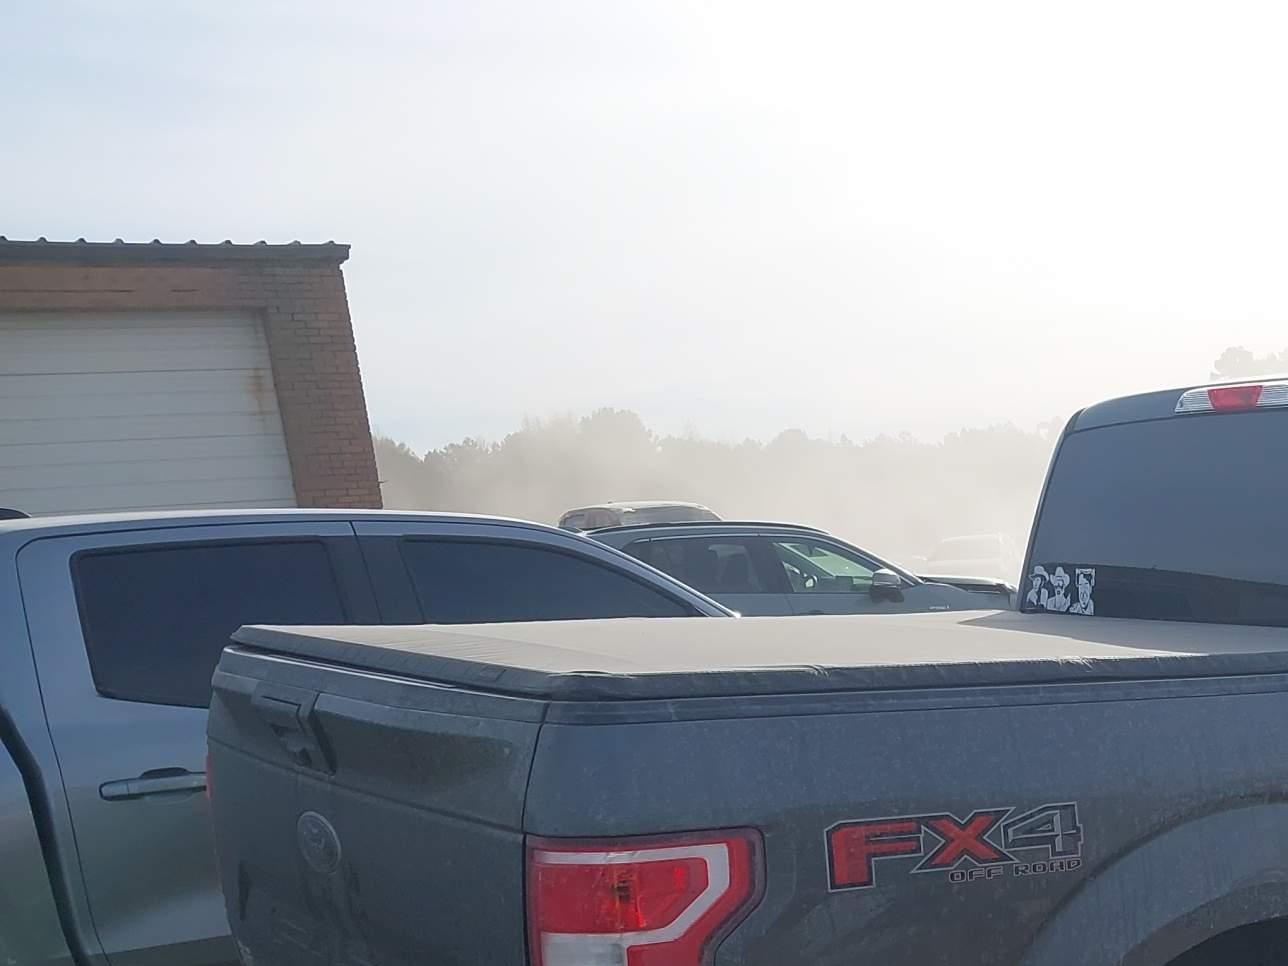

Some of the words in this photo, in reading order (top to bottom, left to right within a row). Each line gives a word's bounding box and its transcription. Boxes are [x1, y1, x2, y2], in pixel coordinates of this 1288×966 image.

[824, 801, 1085, 893] FX4
[949, 866, 1004, 883] OFF
[1013, 859, 1082, 877] ROAD
